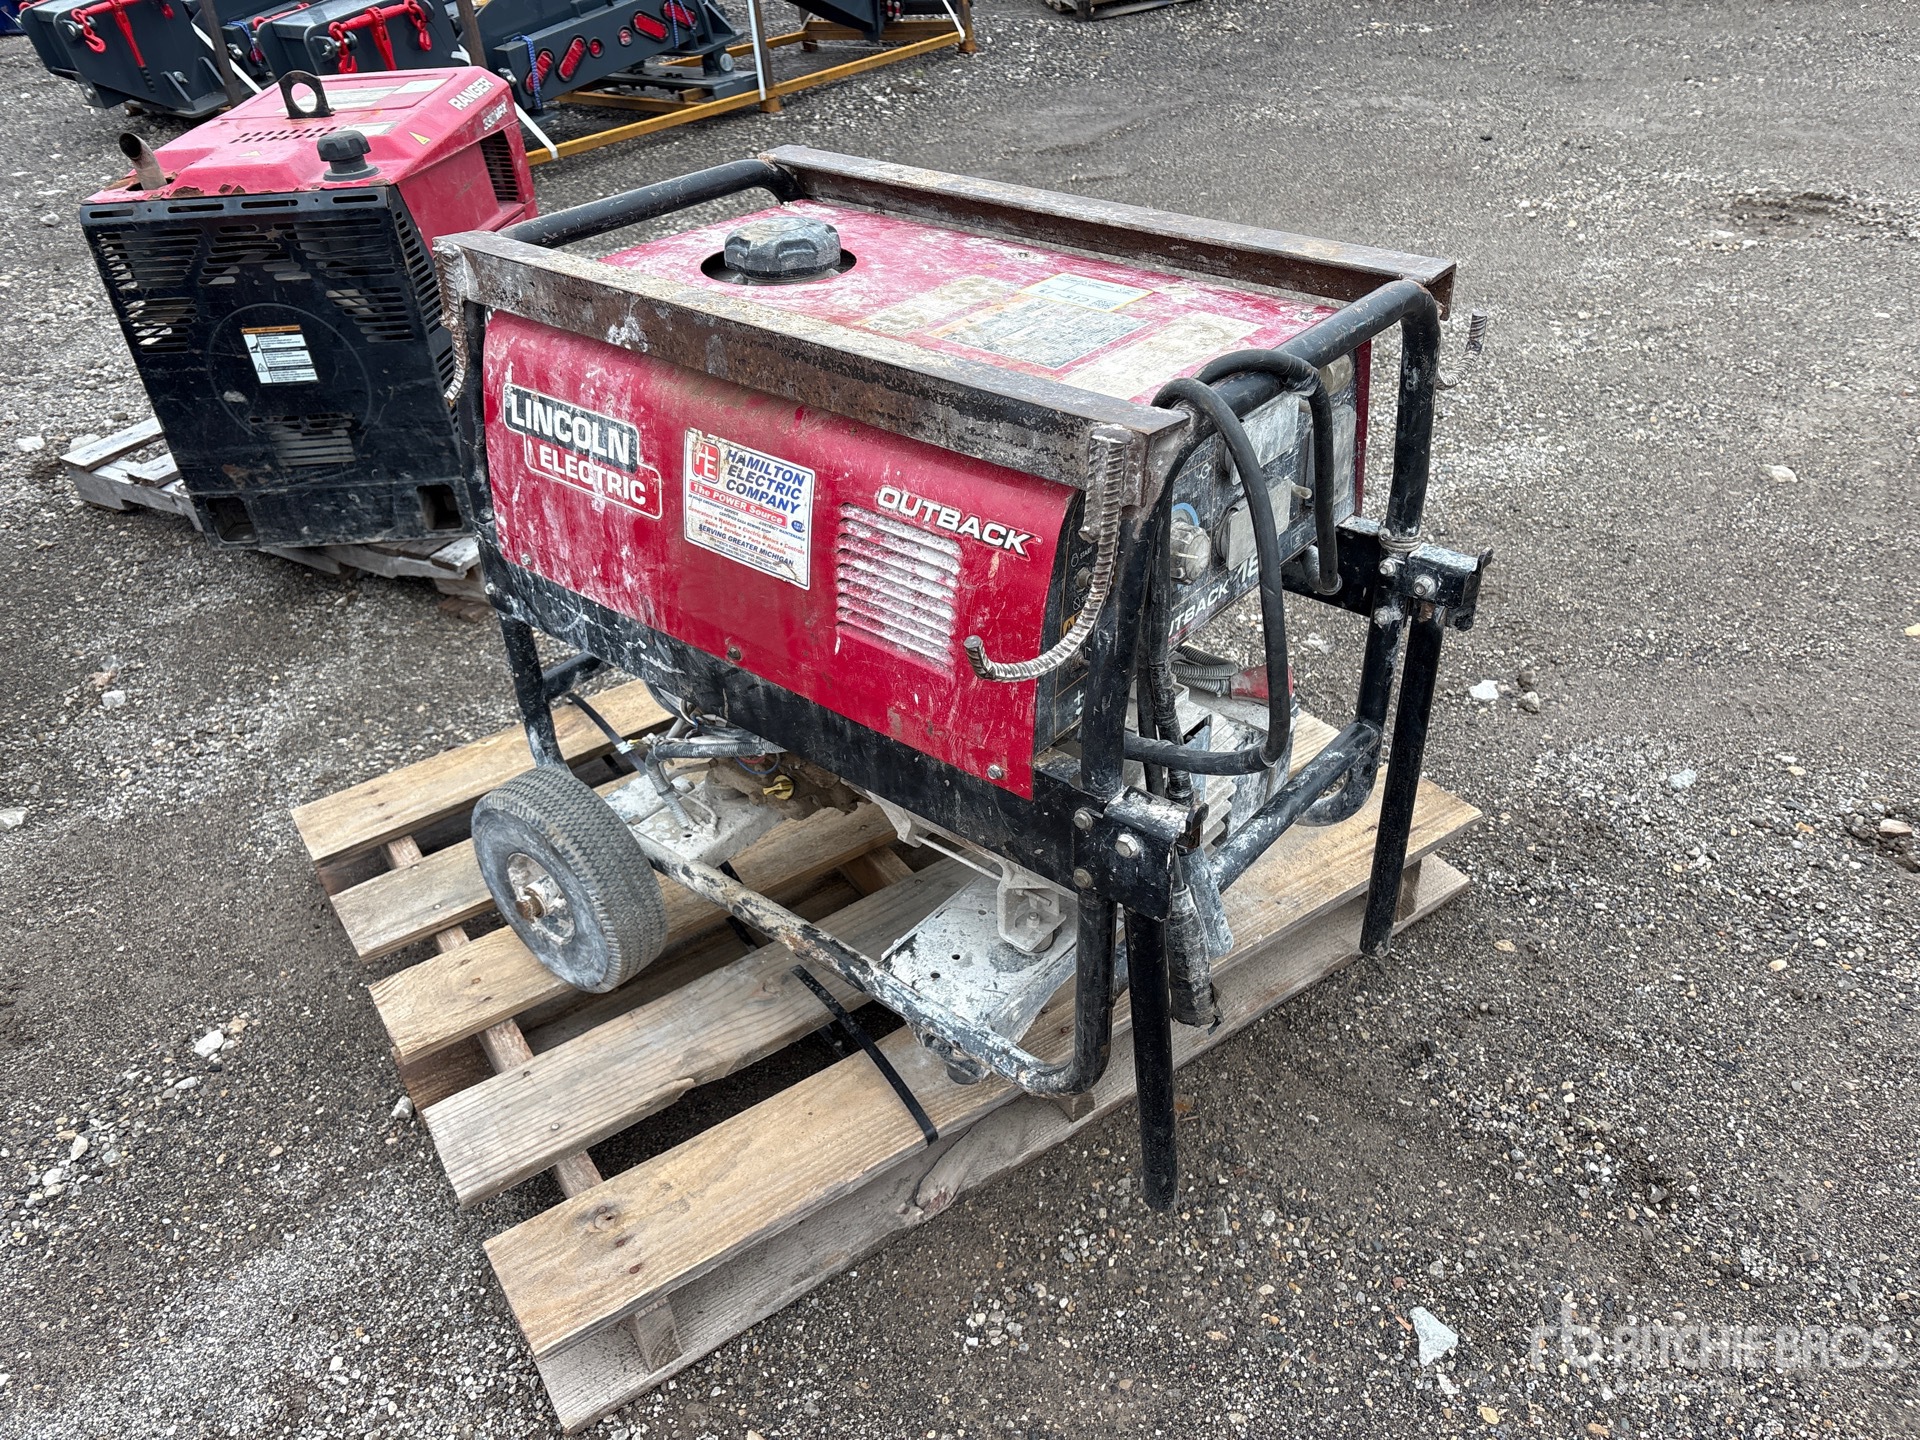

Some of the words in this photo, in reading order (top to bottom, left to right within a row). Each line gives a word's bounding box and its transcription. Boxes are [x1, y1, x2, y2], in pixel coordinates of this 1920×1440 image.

[447, 75, 495, 111] RANGER
[510, 394, 630, 466] LINCOLN
[538, 444, 646, 505] ELECTRIC
[726, 449, 806, 487] HAMILTON
[727, 465, 802, 500] ELECTRIC
[693, 483, 711, 497] The
[712, 490, 748, 511] POWER
[748, 505, 783, 524] Source
[726, 479, 801, 514] COMPANY
[718, 517, 737, 529] Welders
[742, 526, 761, 539] Electric
[784, 543, 806, 555] Controls
[876, 485, 1031, 555] OUTBACK
[698, 523, 727, 539] SERVING
[727, 535, 759, 552] GREATER
[758, 546, 794, 567] MICHIGAN
[747, 535, 762, 546] Parts
[766, 543, 787, 555] Rentals
